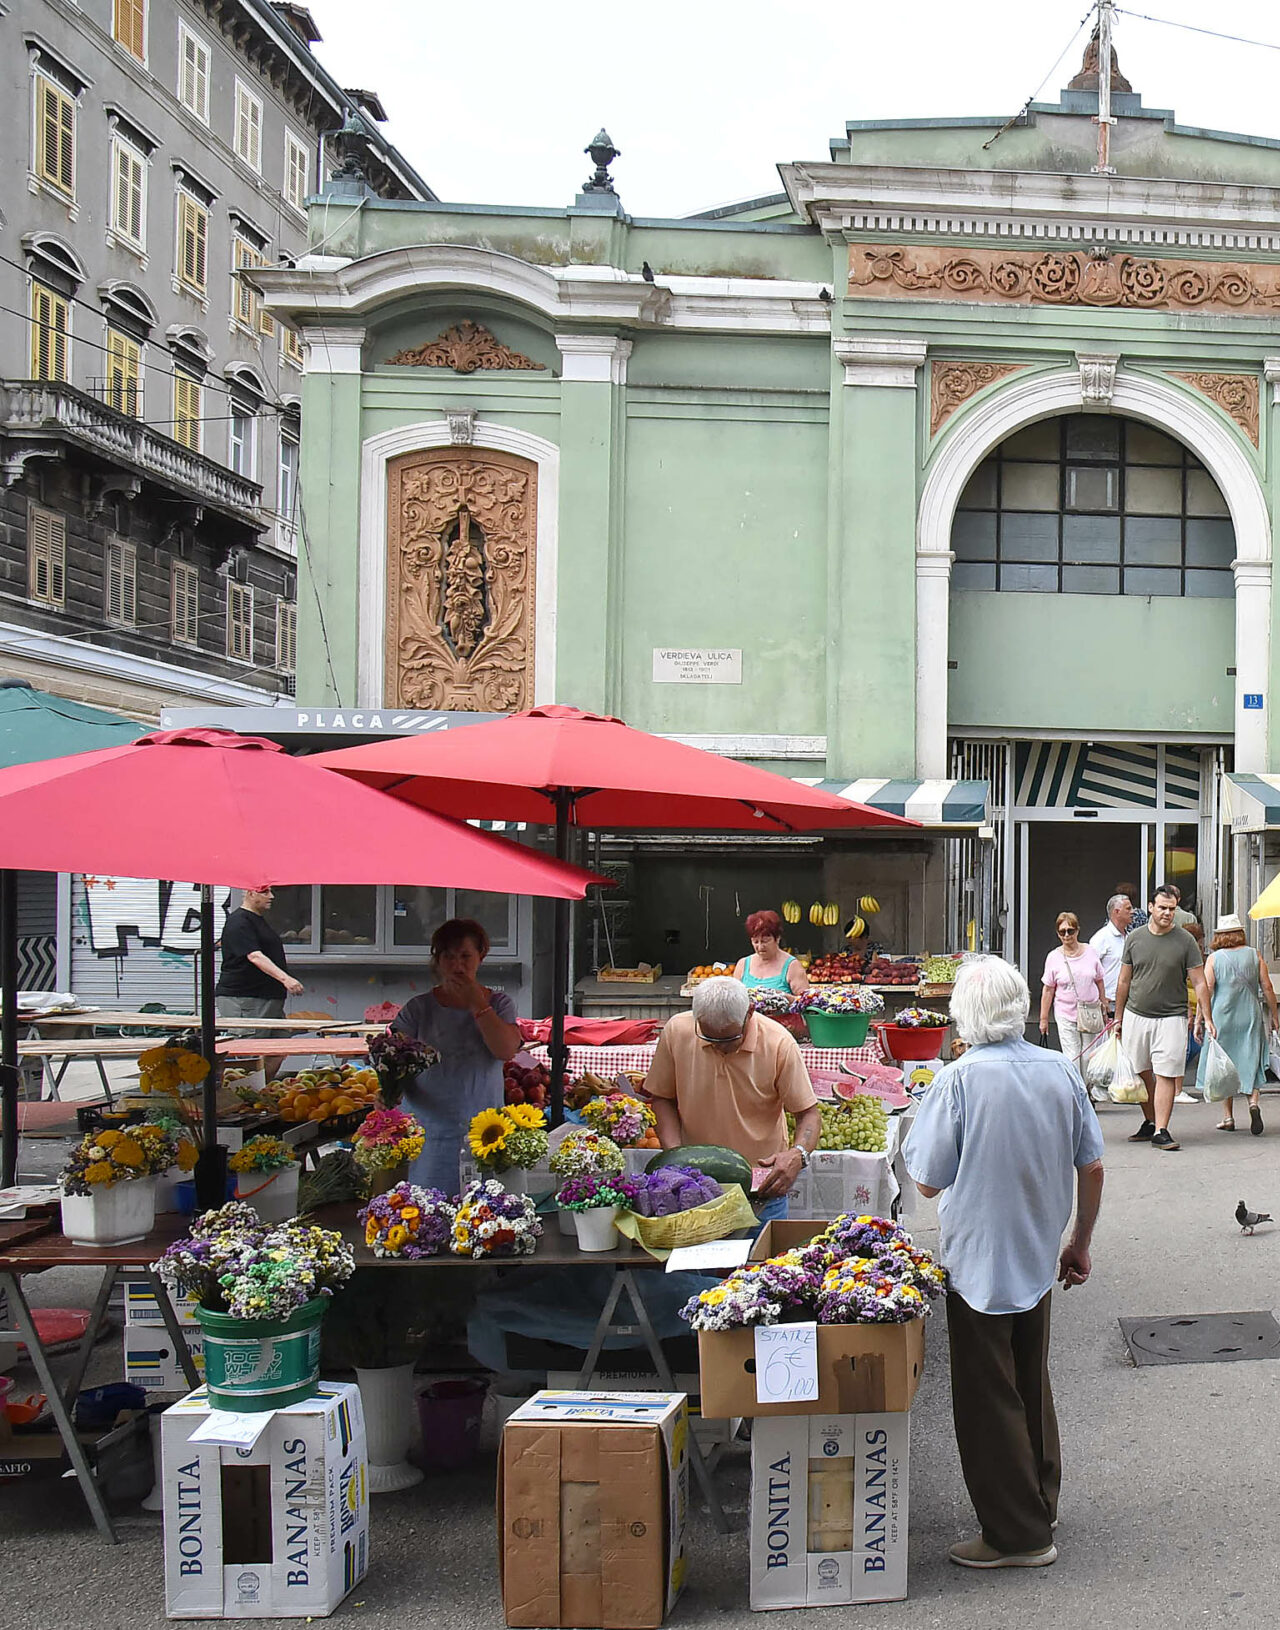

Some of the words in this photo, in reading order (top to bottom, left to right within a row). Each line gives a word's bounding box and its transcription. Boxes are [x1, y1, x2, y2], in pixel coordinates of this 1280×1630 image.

[660, 652, 702, 660] VERDIEVA
[1249, 695, 1258, 705] 13
[297, 713, 384, 729] PLACA
[600, 1370, 648, 1380] PREMIUM
[563, 1407, 615, 1417] BONITA
[893, 1477, 899, 1491] OR
[340, 1460, 355, 1536] BONITA
[864, 1429, 888, 1574] BANANAS
[177, 1456, 203, 1577] BONITA
[284, 1438, 309, 1588] BANANAS
[767, 1454, 791, 1570] BONITA
[892, 1509, 898, 1521] AT
[313, 1524, 320, 1534] AT
[313, 1538, 321, 1557] KEEP
